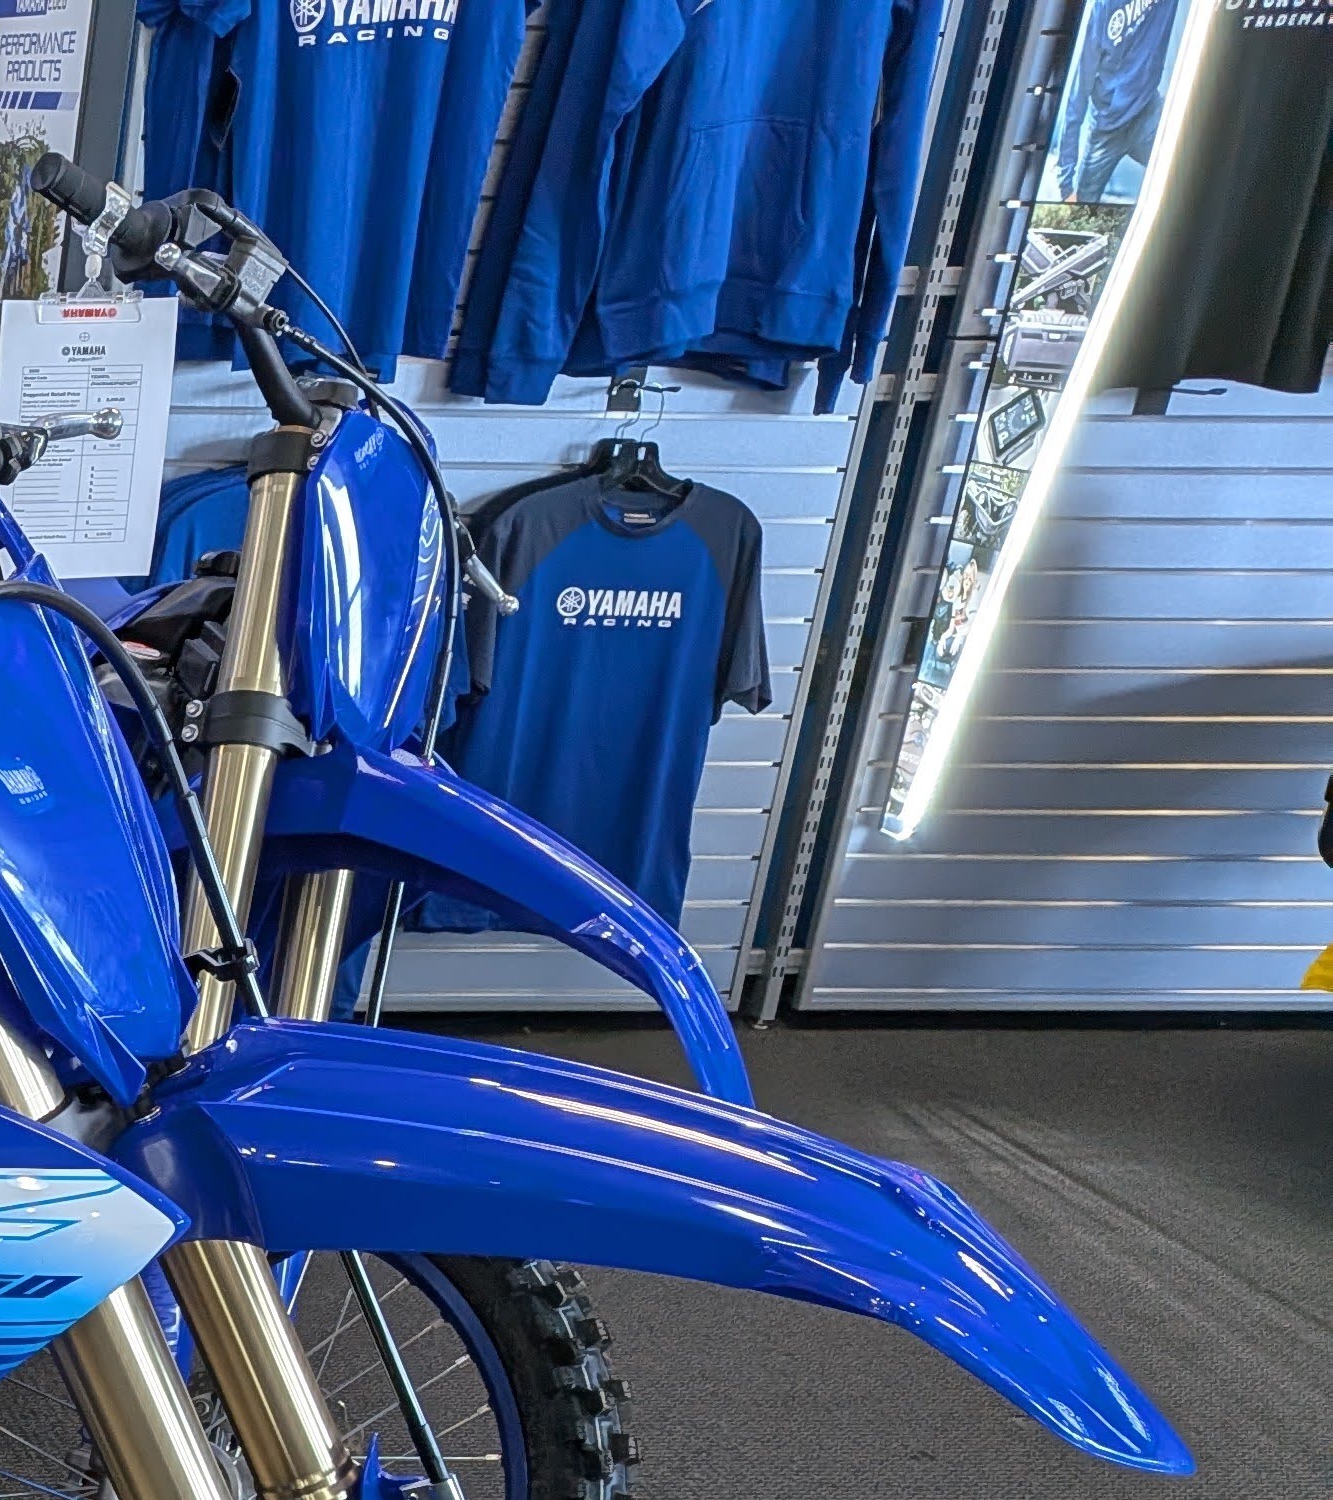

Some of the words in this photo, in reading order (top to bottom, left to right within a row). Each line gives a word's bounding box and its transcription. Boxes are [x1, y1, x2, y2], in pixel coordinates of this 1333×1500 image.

[0, 30, 77, 56] PERFORMANCE
[298, 26, 450, 47] RACING
[6, 59, 62, 82] PRODUCTS
[71, 345, 106, 356] YAMAHA
[587, 589, 682, 619] YAMAHA
[563, 617, 673, 628] RACING
